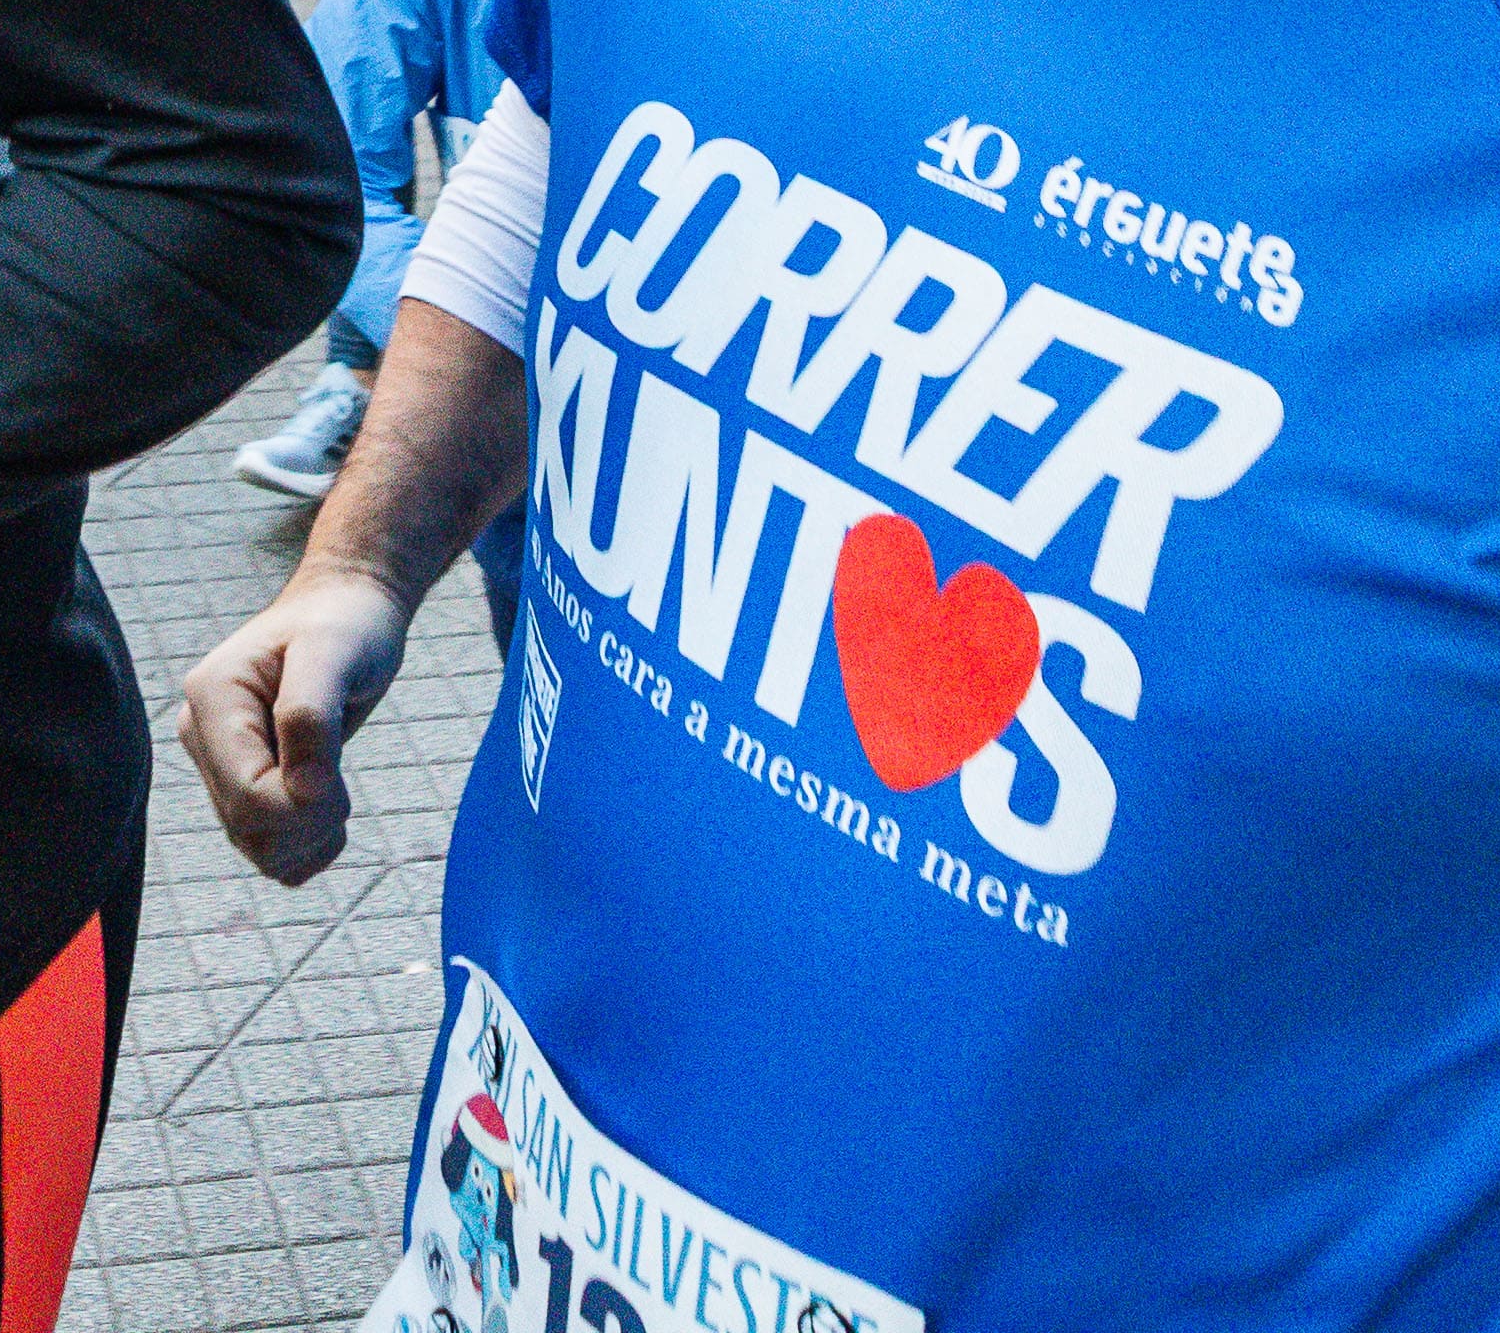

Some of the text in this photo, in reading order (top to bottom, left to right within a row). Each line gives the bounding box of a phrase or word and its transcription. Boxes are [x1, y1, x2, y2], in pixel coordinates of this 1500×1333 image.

[923, 114, 1021, 191] 40
[556, 100, 1285, 613] CORRER
[599, 629, 674, 718] cara
[684, 699, 710, 744] a
[722, 722, 902, 865] mesma
[920, 836, 1072, 949] meta
[514, 1067, 574, 1220] SAN
